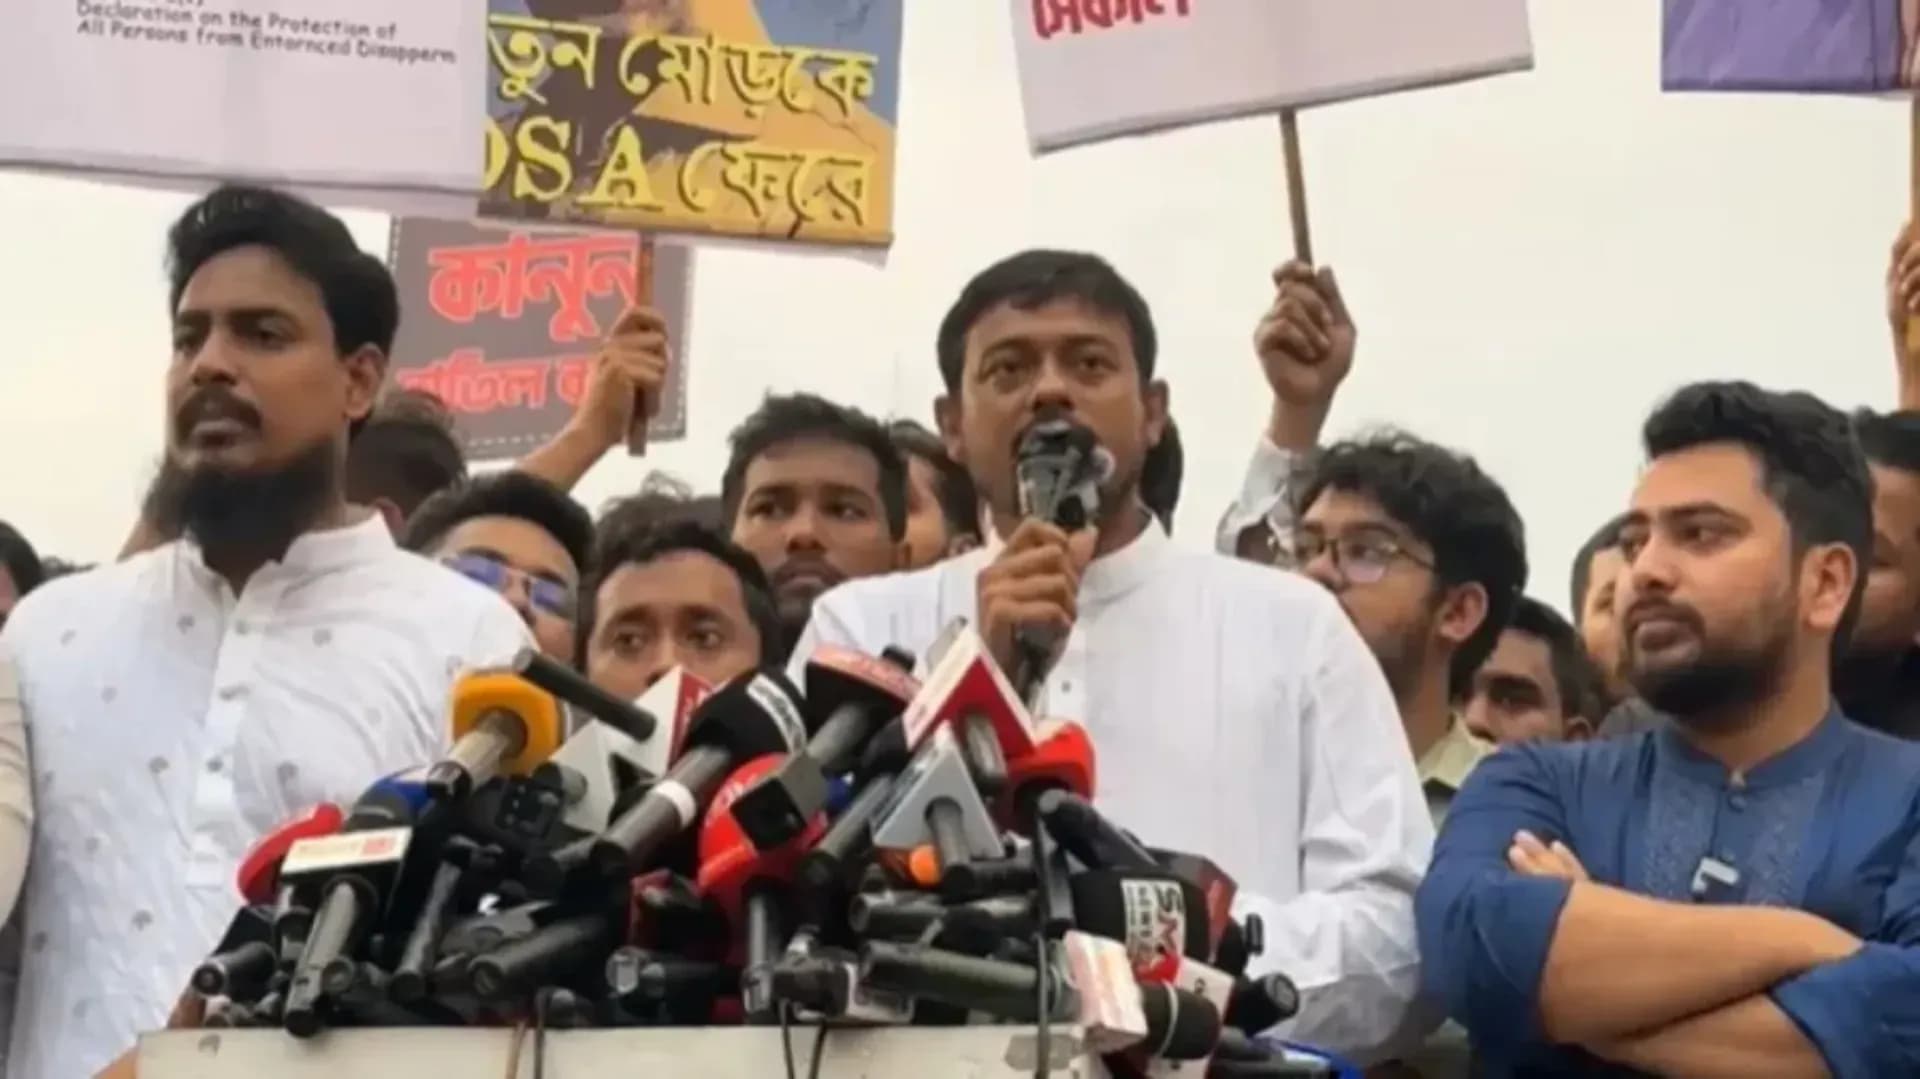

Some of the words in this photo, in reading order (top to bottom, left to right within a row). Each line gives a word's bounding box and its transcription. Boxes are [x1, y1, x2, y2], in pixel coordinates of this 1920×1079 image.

[77, 18, 105, 35] All
[111, 20, 188, 43] Persons
[197, 27, 244, 46] from
[200, 12, 223, 27] on
[229, 10, 262, 28] the
[268, 12, 370, 37] Protection
[375, 21, 397, 40] of
